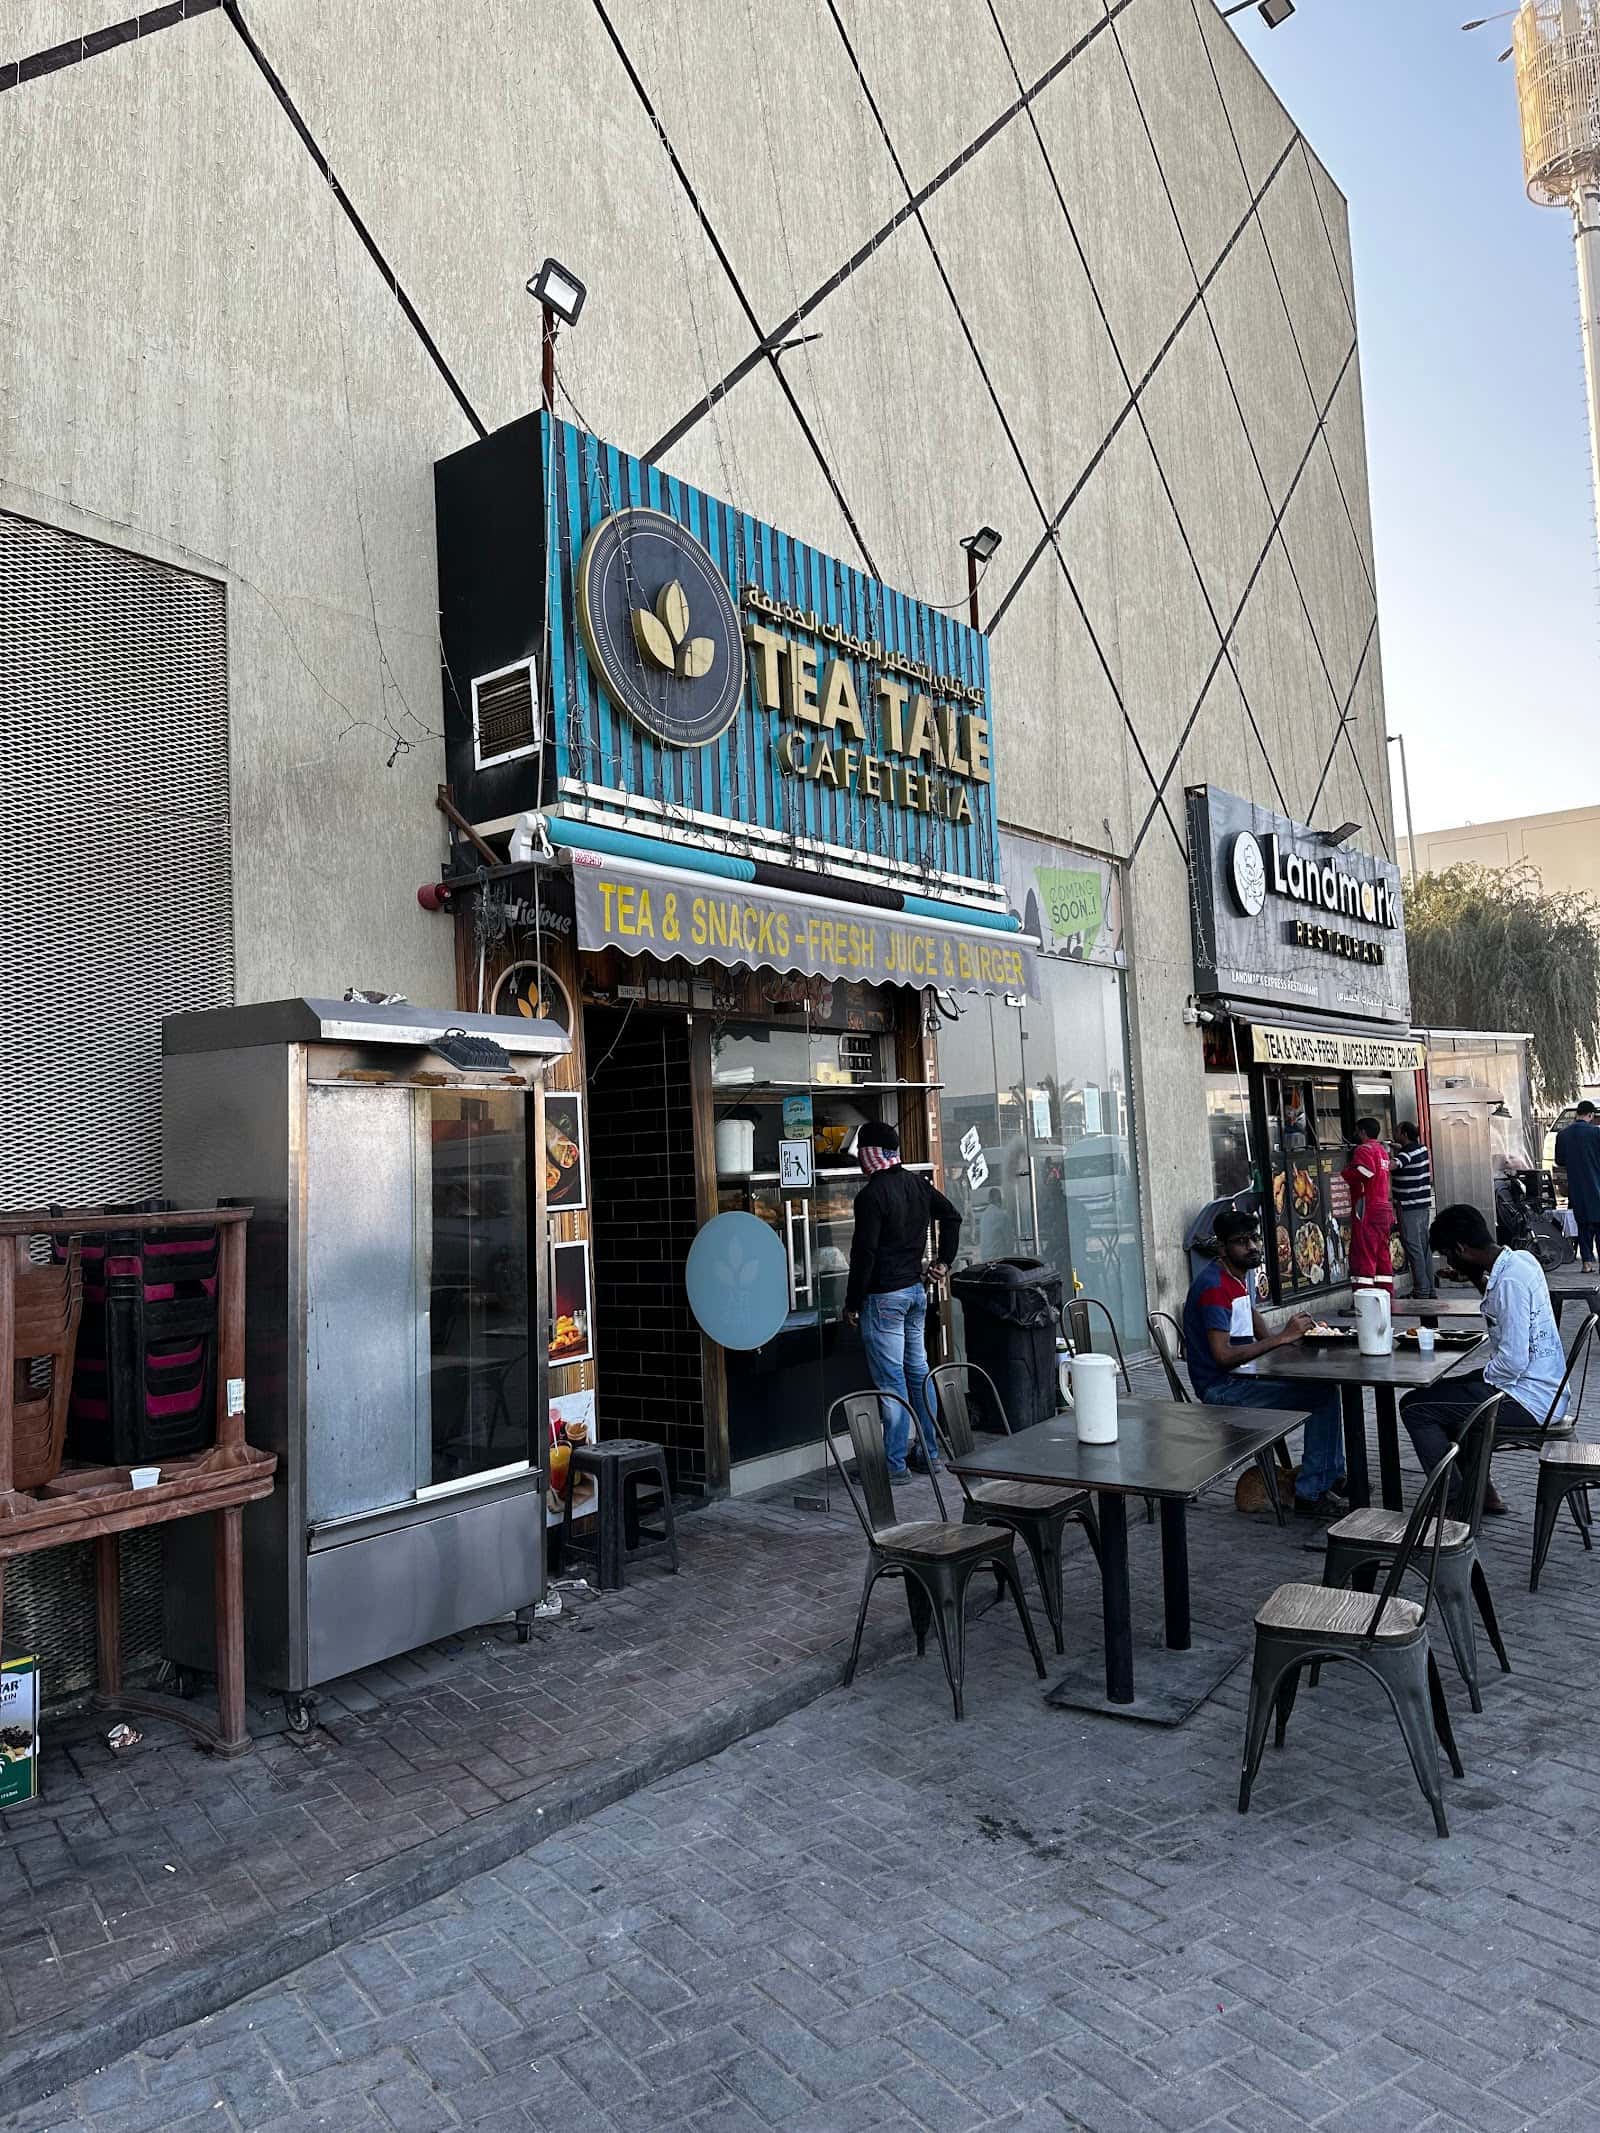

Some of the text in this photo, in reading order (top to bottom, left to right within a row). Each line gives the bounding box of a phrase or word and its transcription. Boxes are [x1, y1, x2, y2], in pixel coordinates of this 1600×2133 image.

[747, 582, 819, 634] الخفيفة
[822, 623, 882, 661] الوجبات
[748, 623, 990, 785] TEA TALE
[779, 730, 974, 825] CAFETERIA
[1049, 879, 1093, 904] COMING
[1272, 832, 1398, 930] Landmark
[598, 881, 655, 938] TEA
[662, 892, 680, 942] &
[885, 929, 938, 976] JUICE
[943, 942, 955, 977] &
[959, 942, 1025, 985] BURGER
[1296, 919, 1386, 965] RESTAURANT
[1264, 975, 1287, 991] EXPRESS
[1287, 979, 1319, 997] RESTAURANT
[1264, 1033, 1284, 1059] TEA
[1283, 1034, 1292, 1060] &
[1342, 1042, 1363, 1066] JUICES
[1363, 1043, 1369, 1066] &
[1369, 1044, 1396, 1068] BROSTED
